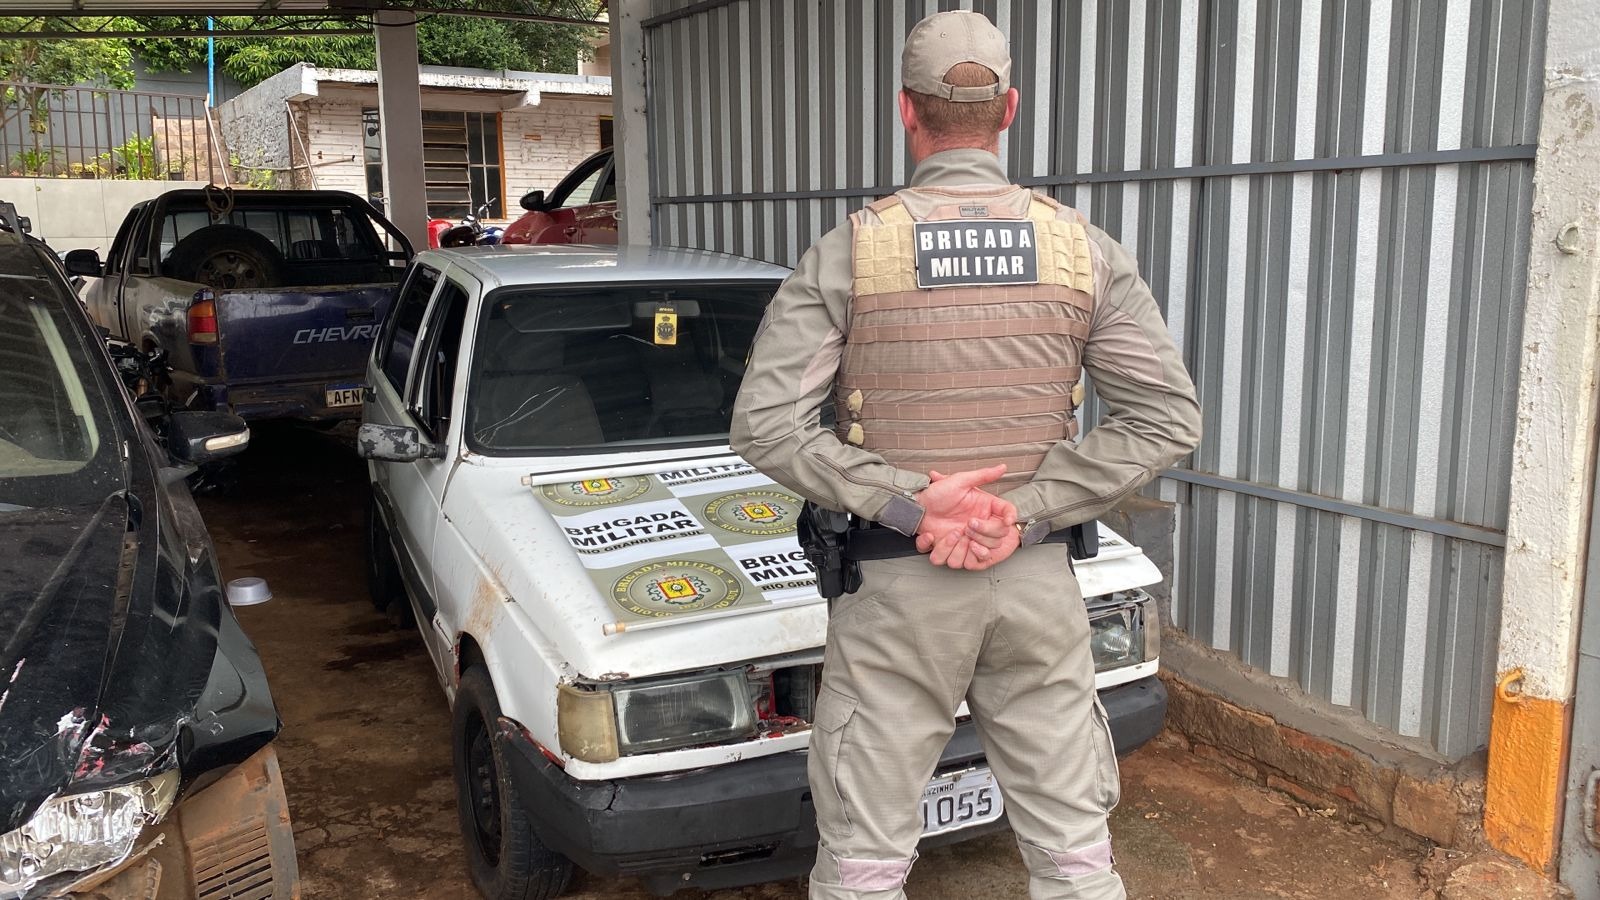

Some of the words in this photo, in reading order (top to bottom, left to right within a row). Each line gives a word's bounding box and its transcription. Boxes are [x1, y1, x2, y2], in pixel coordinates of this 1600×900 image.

[920, 229, 1032, 251] BRIGADA
[931, 256, 1024, 278] MILITAR
[293, 324, 381, 344] CHEVR
[334, 389, 365, 405] AFN
[659, 463, 752, 481] MILITA
[564, 510, 688, 536] BRIGADA
[570, 519, 697, 547] MILITAR
[604, 537, 656, 552] GRANDE
[681, 530, 704, 538] SUL
[739, 551, 804, 570] BRIG
[616, 563, 662, 593] BRIGADA
[666, 560, 725, 576] MILITAR
[749, 562, 816, 582] MILI
[761, 583, 784, 591] RIO
[787, 580, 817, 588] GRA
